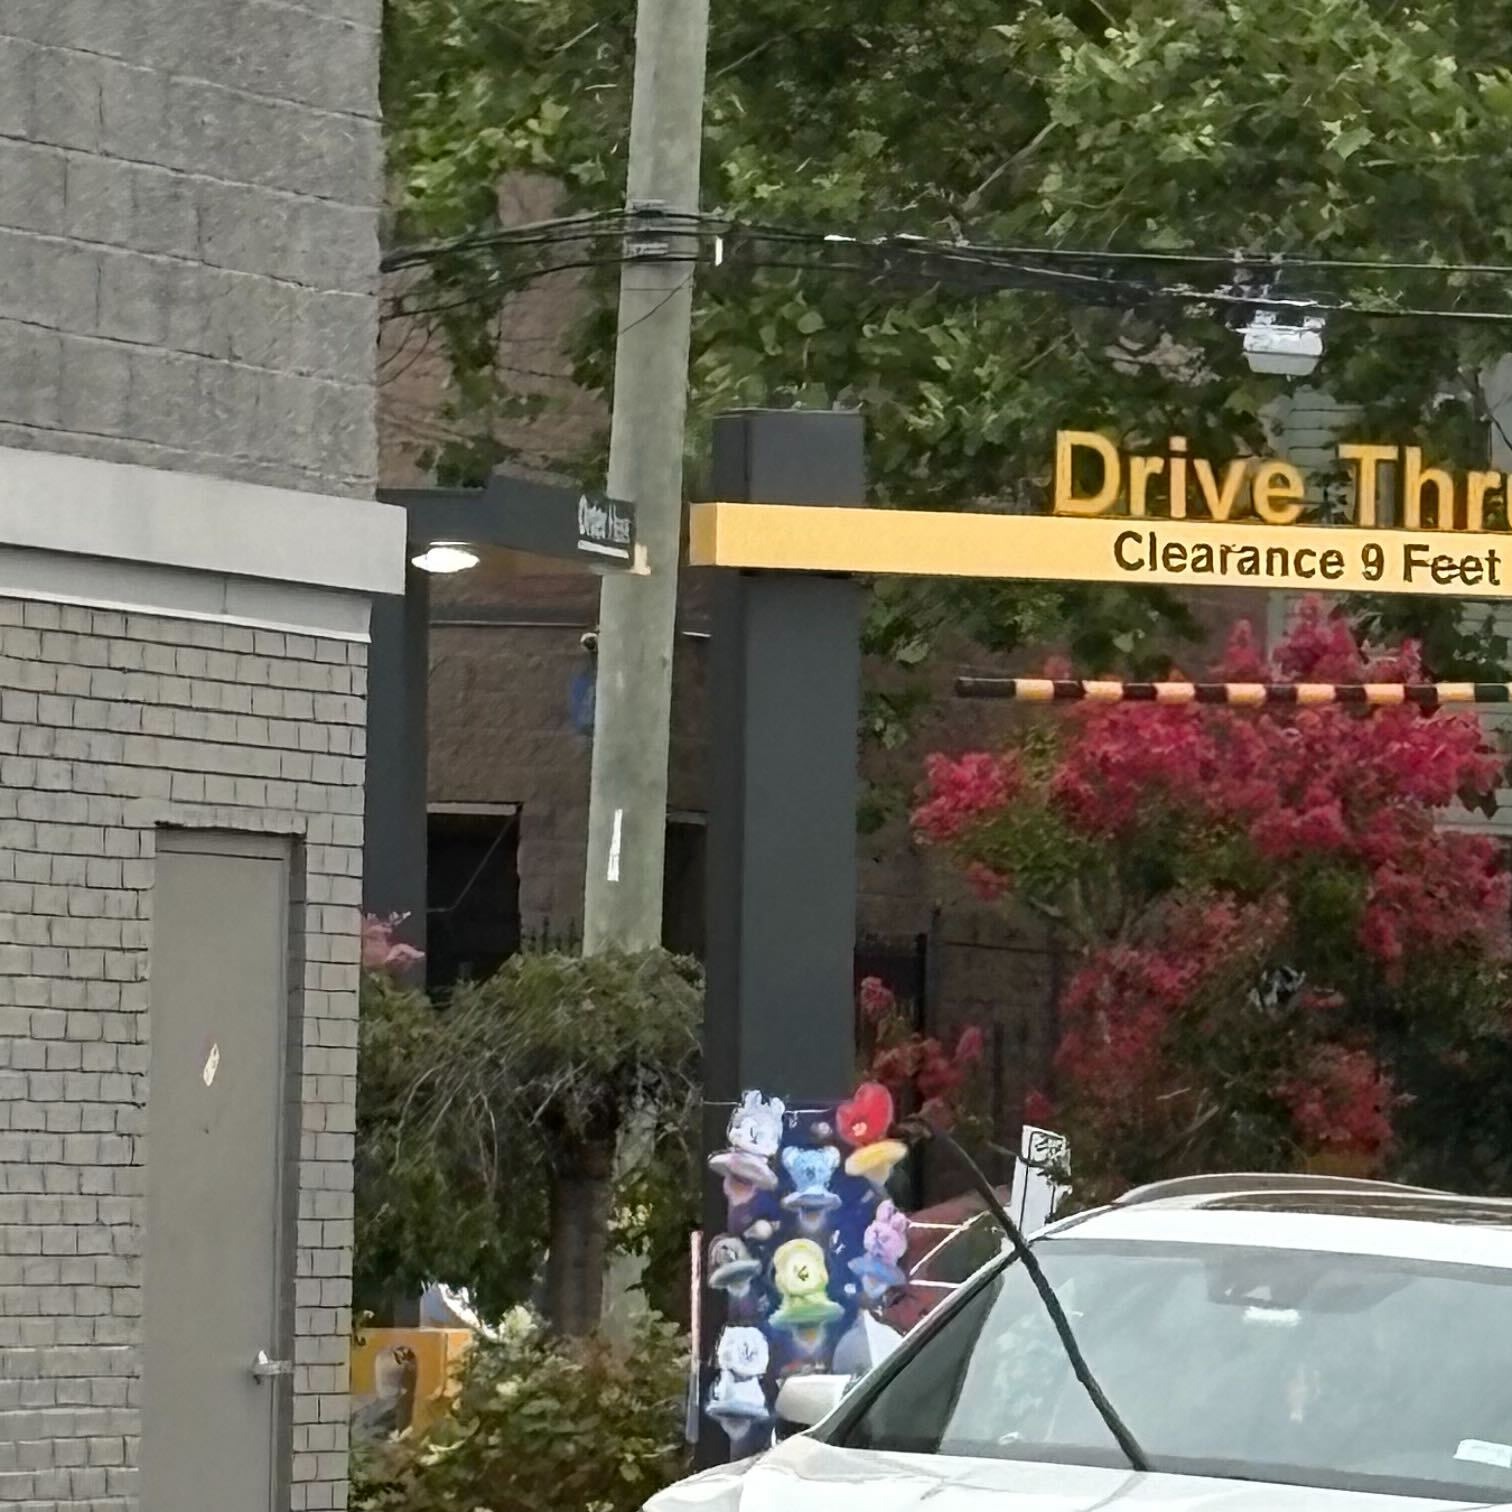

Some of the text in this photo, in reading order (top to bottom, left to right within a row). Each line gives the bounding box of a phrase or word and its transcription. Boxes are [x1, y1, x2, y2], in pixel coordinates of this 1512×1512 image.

[1055, 430, 1304, 524] Drive
[1114, 530, 1502, 587] Clearance 9 Feet
